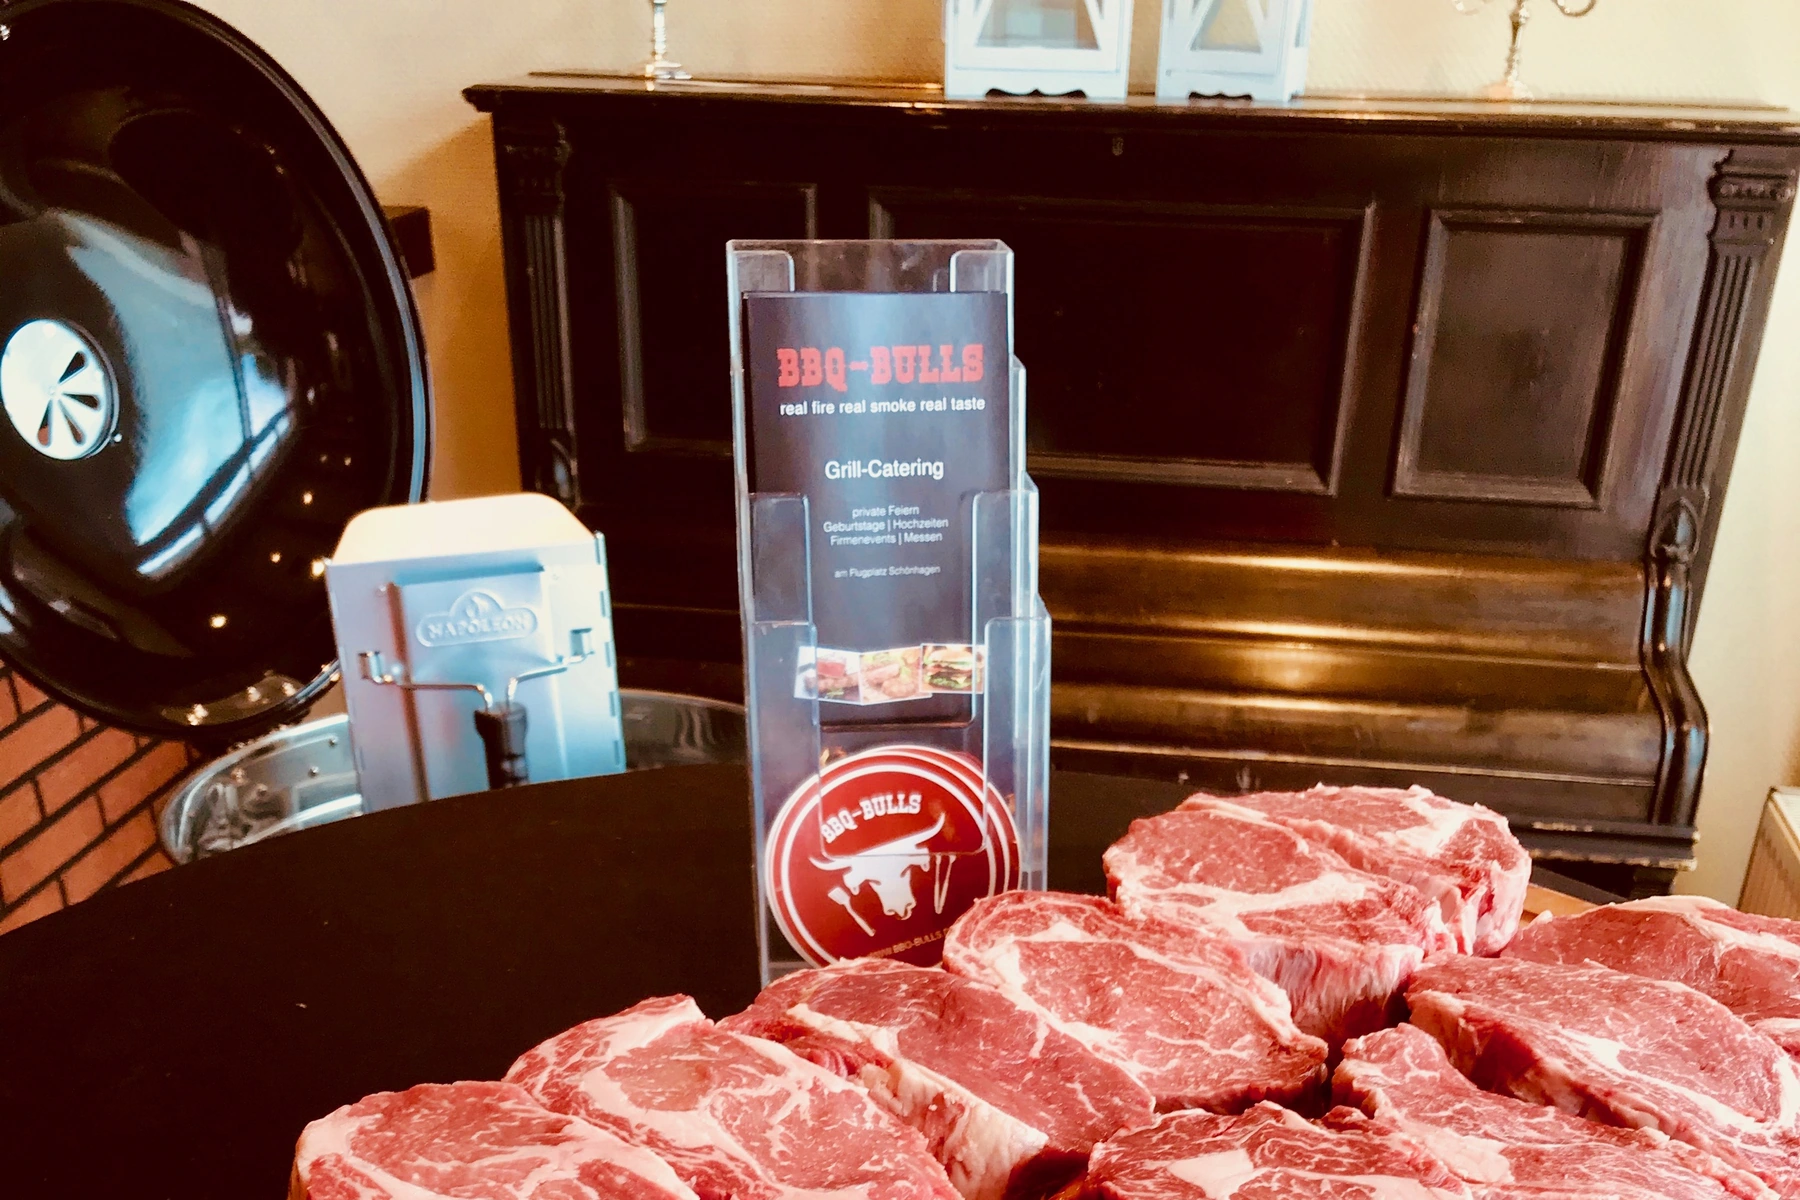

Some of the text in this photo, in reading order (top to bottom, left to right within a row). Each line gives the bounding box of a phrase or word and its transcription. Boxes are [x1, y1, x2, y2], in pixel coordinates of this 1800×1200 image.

[777, 343, 984, 391] BBQ-BULLS
[780, 396, 985, 416] real fire real smoke real taste
[824, 458, 944, 480] Grill-Catering
[852, 505, 919, 519] private Feiern
[823, 518, 949, 533] Geburtstage Hochzeiten
[830, 532, 943, 546] Firmenevents Messen
[834, 570, 848, 578] am
[849, 568, 887, 578] Flugplatz
[427, 614, 527, 640] NAPOLEON
[821, 793, 922, 844] BBQ-BULLS
